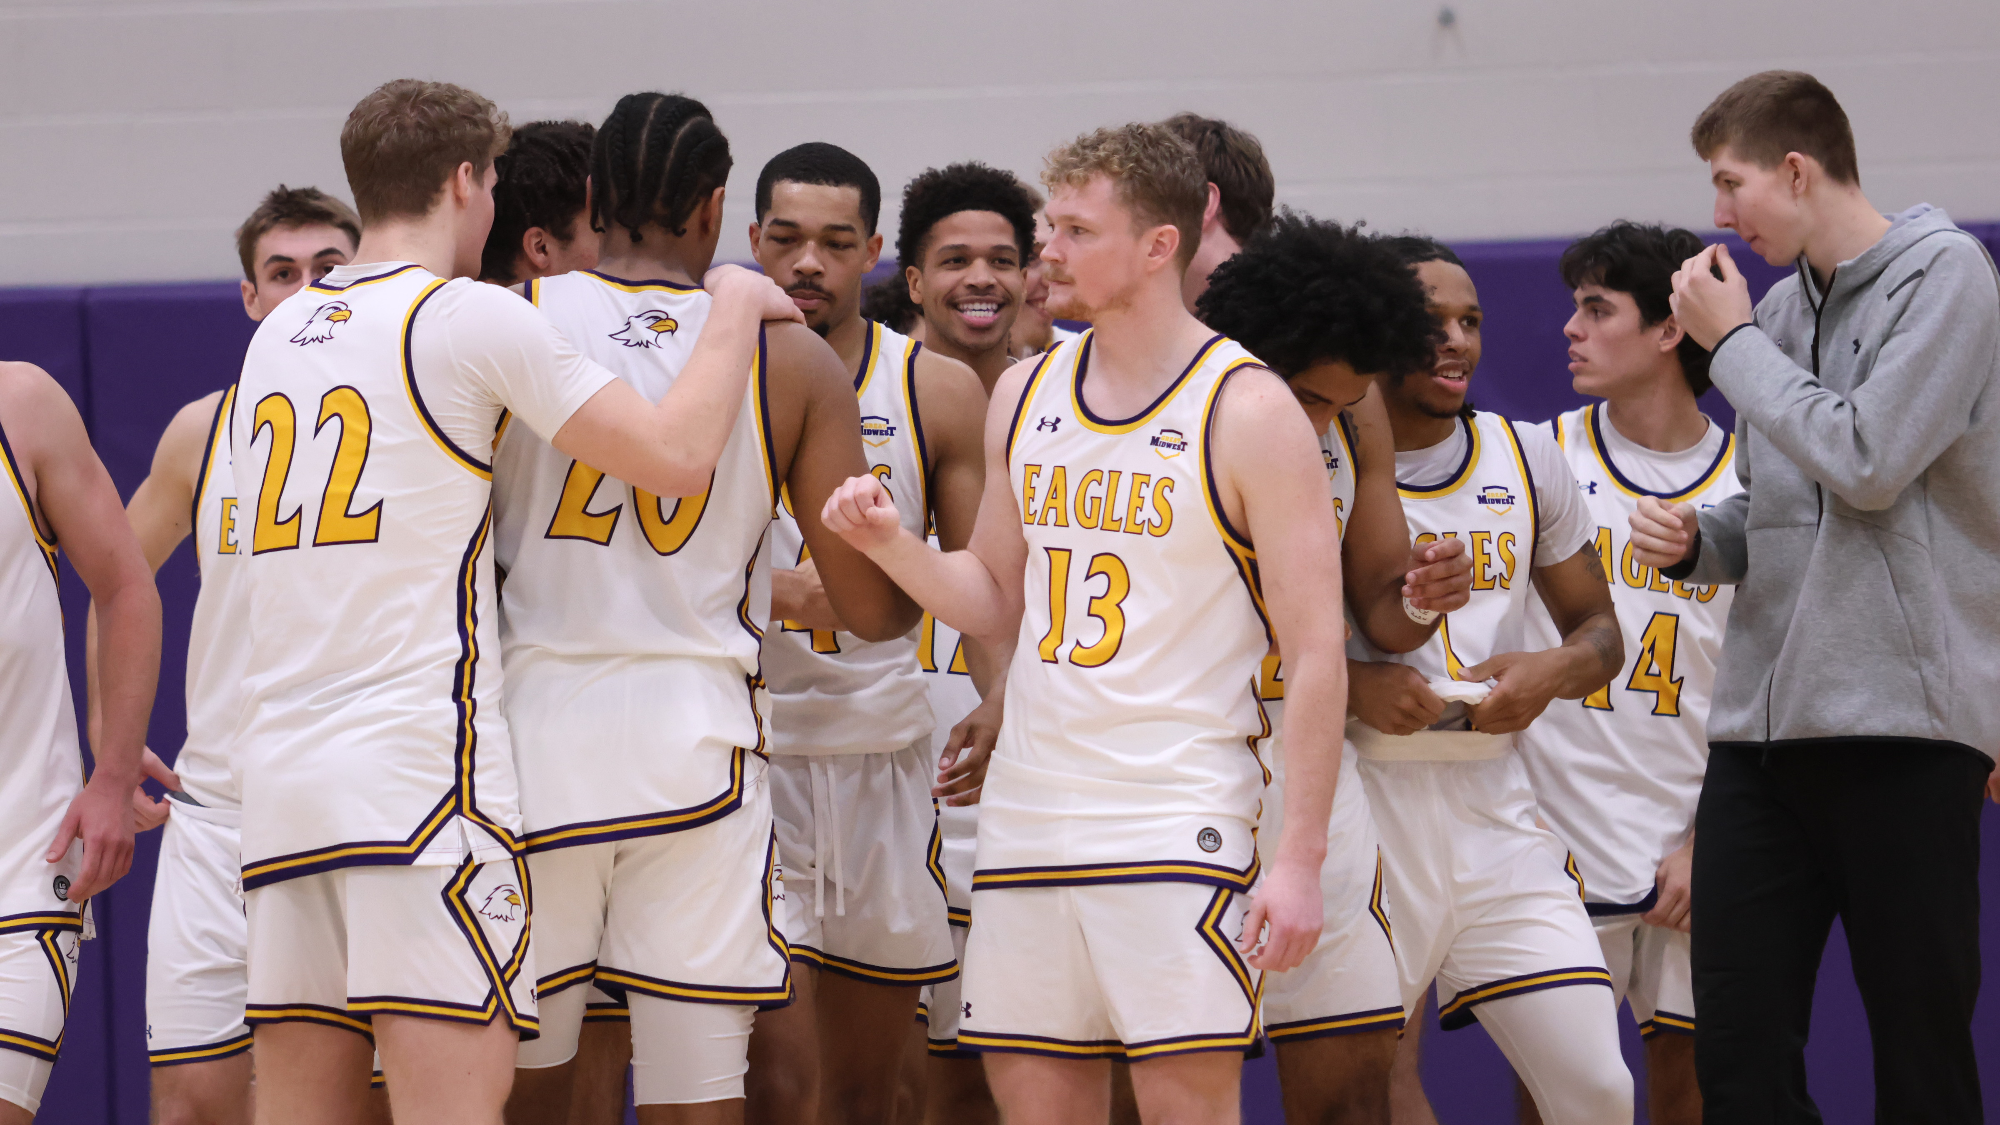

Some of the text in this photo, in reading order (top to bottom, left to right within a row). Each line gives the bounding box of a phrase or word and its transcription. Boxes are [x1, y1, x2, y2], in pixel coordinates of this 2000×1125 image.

[250, 385, 384, 556] 22
[1150, 435, 1188, 452] MIDWEST
[1023, 464, 1175, 538] EAGLES
[1476, 494, 1516, 505] MIDWEST
[1038, 547, 1130, 668] 13
